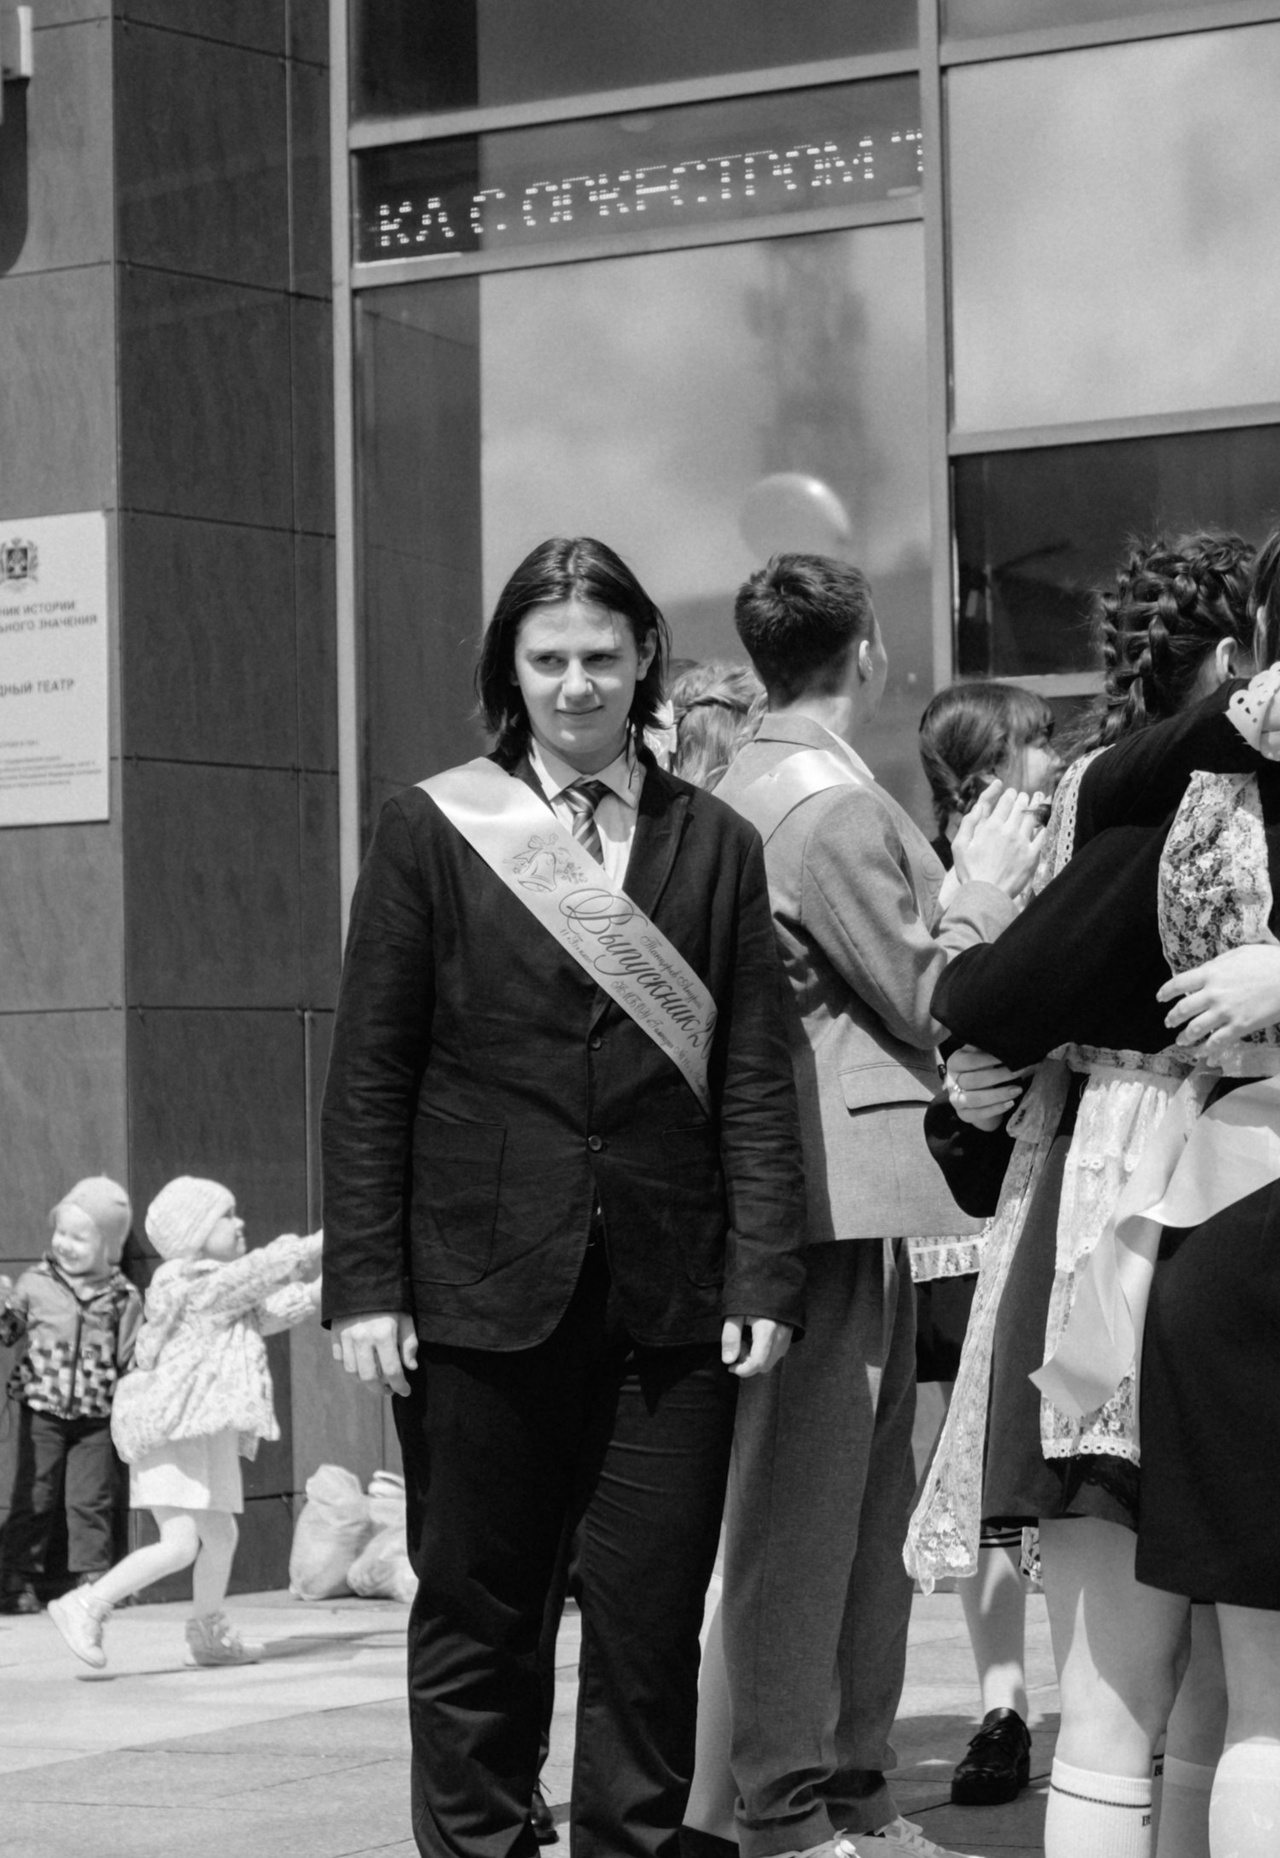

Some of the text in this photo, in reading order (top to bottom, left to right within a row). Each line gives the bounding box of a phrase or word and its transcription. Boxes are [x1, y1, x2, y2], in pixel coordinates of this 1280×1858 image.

[23, 601, 75, 615] ИСТОРИИ
[38, 614, 97, 630] ЗНАЧЕНИЯ
[37, 678, 74, 694] ТЕАТР
[559, 888, 701, 1032] Выпускник
